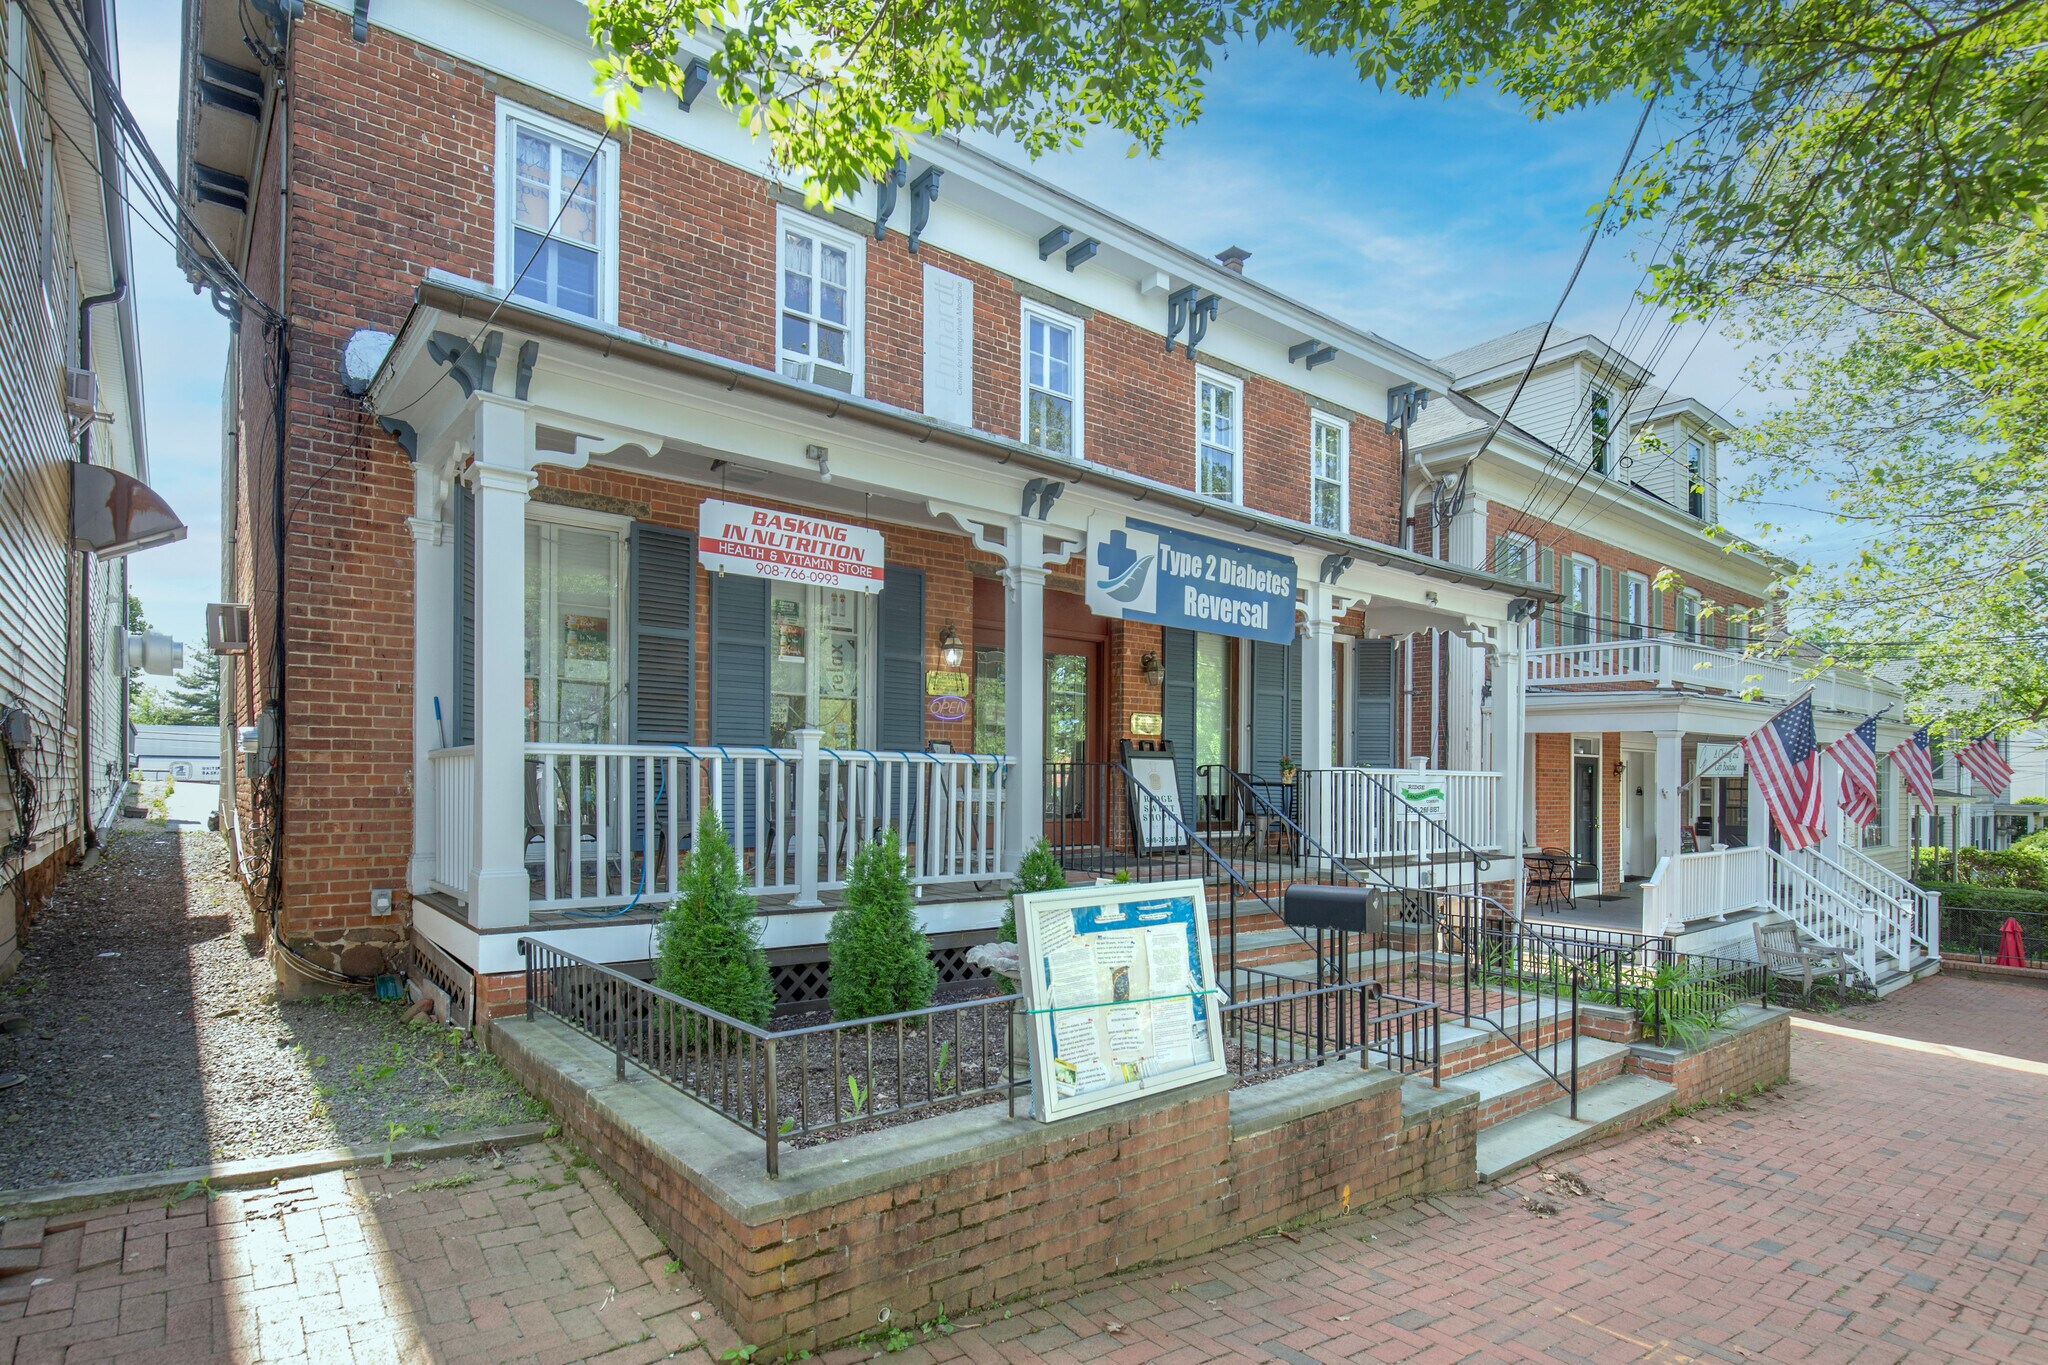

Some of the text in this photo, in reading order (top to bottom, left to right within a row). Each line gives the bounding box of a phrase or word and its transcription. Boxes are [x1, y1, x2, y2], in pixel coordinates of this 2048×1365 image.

[955, 282, 963, 316] Medicine
[934, 278, 955, 392] Ehrhardt
[955, 317, 965, 356] Integrative
[955, 358, 963, 369] for
[722, 523, 865, 562] IN NUTRITION
[751, 511, 848, 542] BASKING
[719, 542, 873, 577] HEALTH & VITAMIN STORE
[755, 562, 839, 586] 908-766-0993
[1160, 543, 1290, 597] Type 2 Diabetes
[1184, 585, 1268, 630] Reversal
[826, 644, 844, 693] relax
[930, 701, 967, 714] OPEN
[1144, 795, 1173, 803] RDGE
